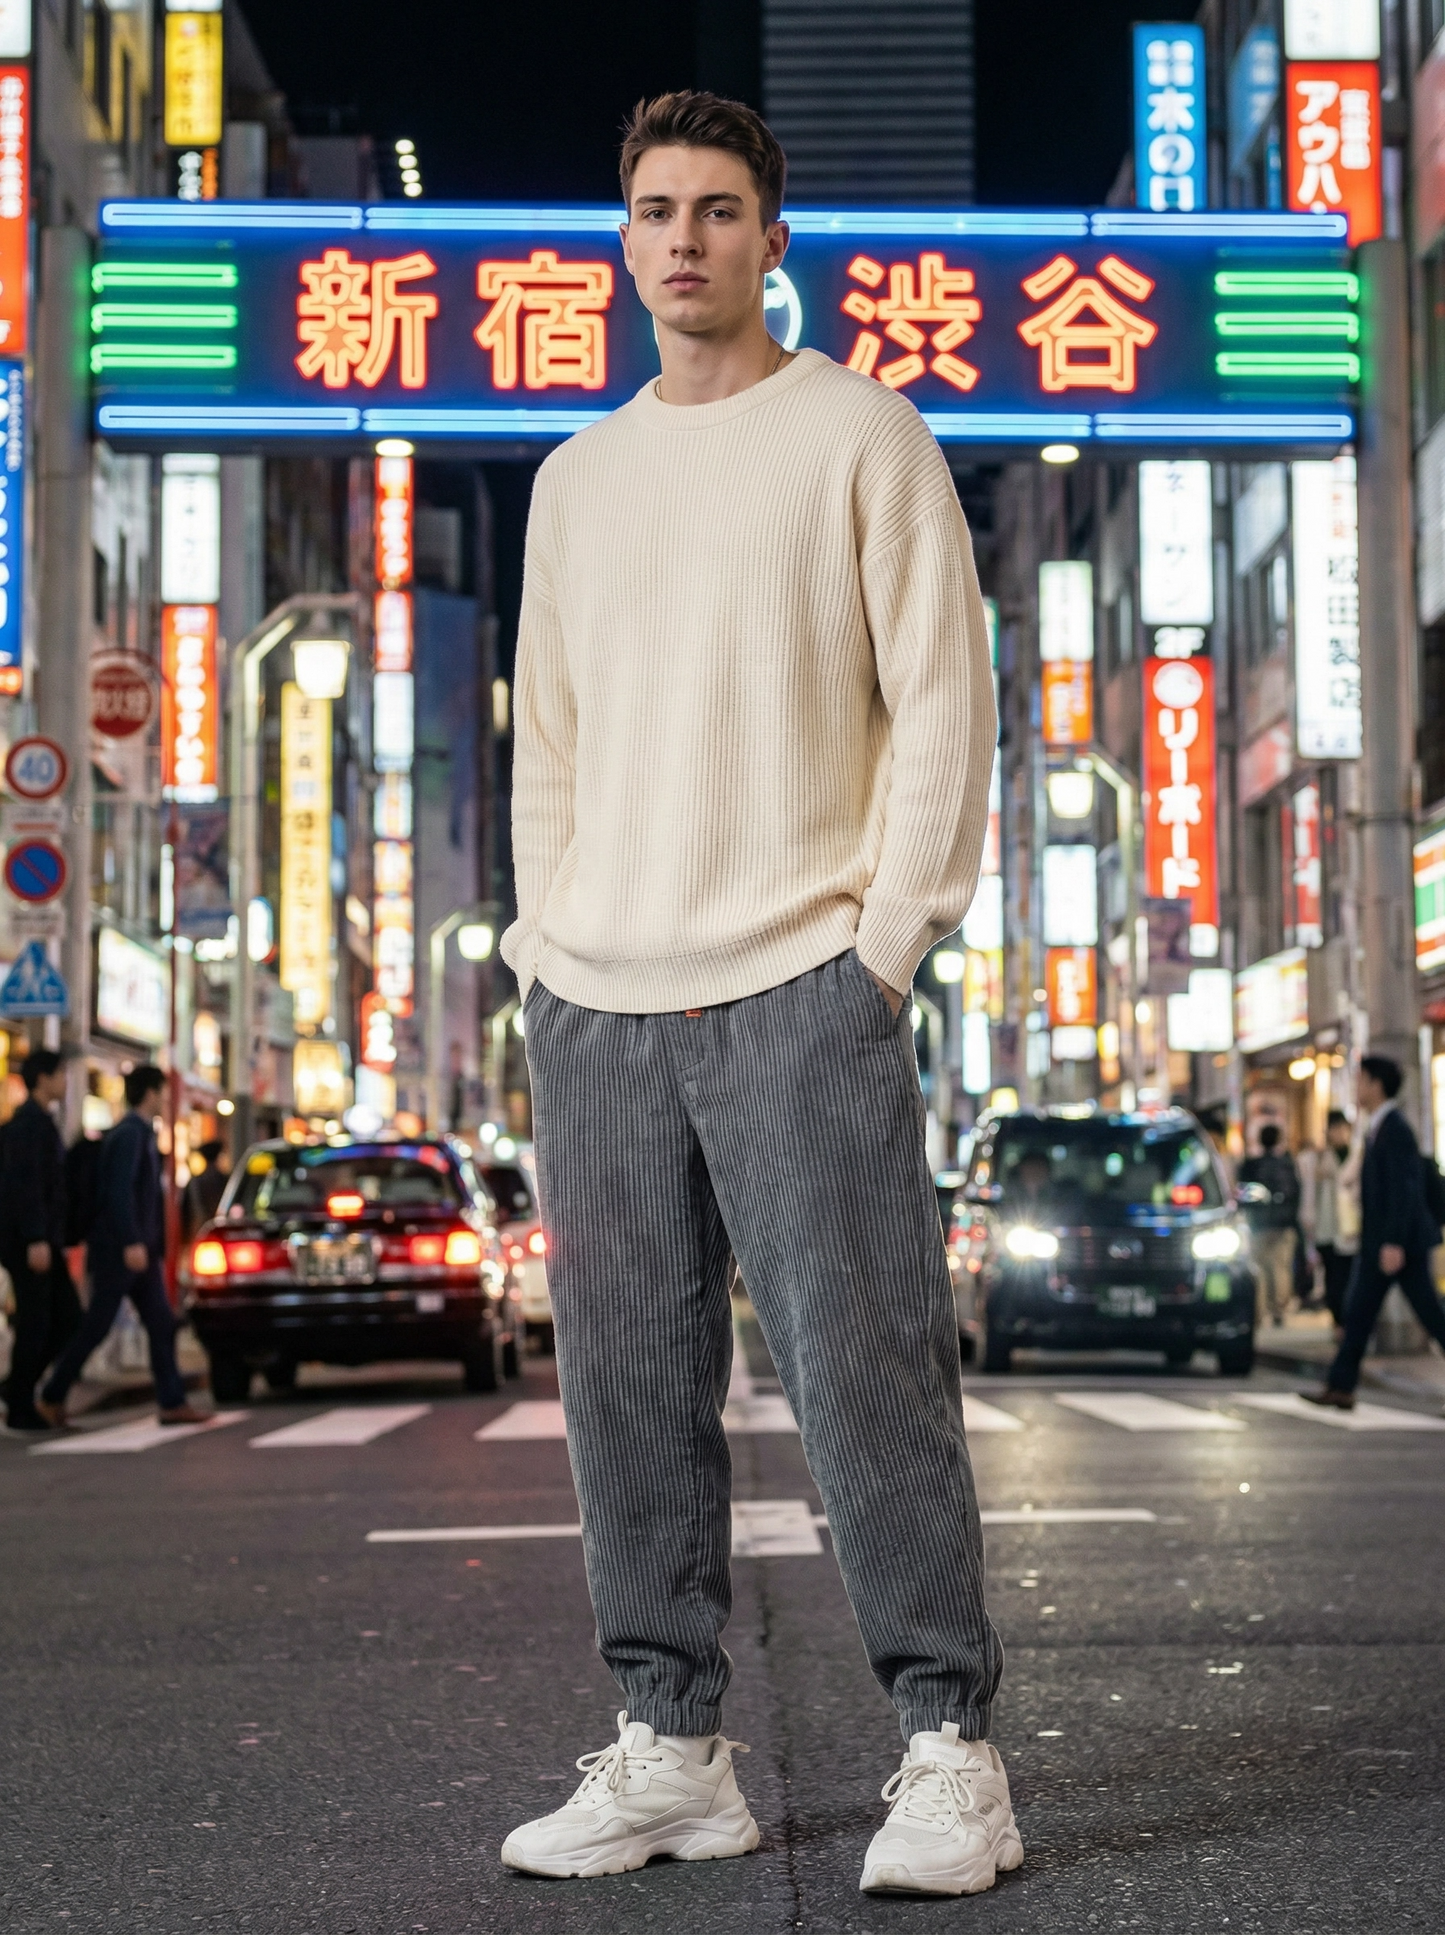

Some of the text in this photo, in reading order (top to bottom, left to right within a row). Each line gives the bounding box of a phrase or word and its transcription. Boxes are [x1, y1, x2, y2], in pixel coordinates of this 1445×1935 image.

[296, 248, 1157, 392] 新宿 渋谷
[19, 755, 55, 785] 40
